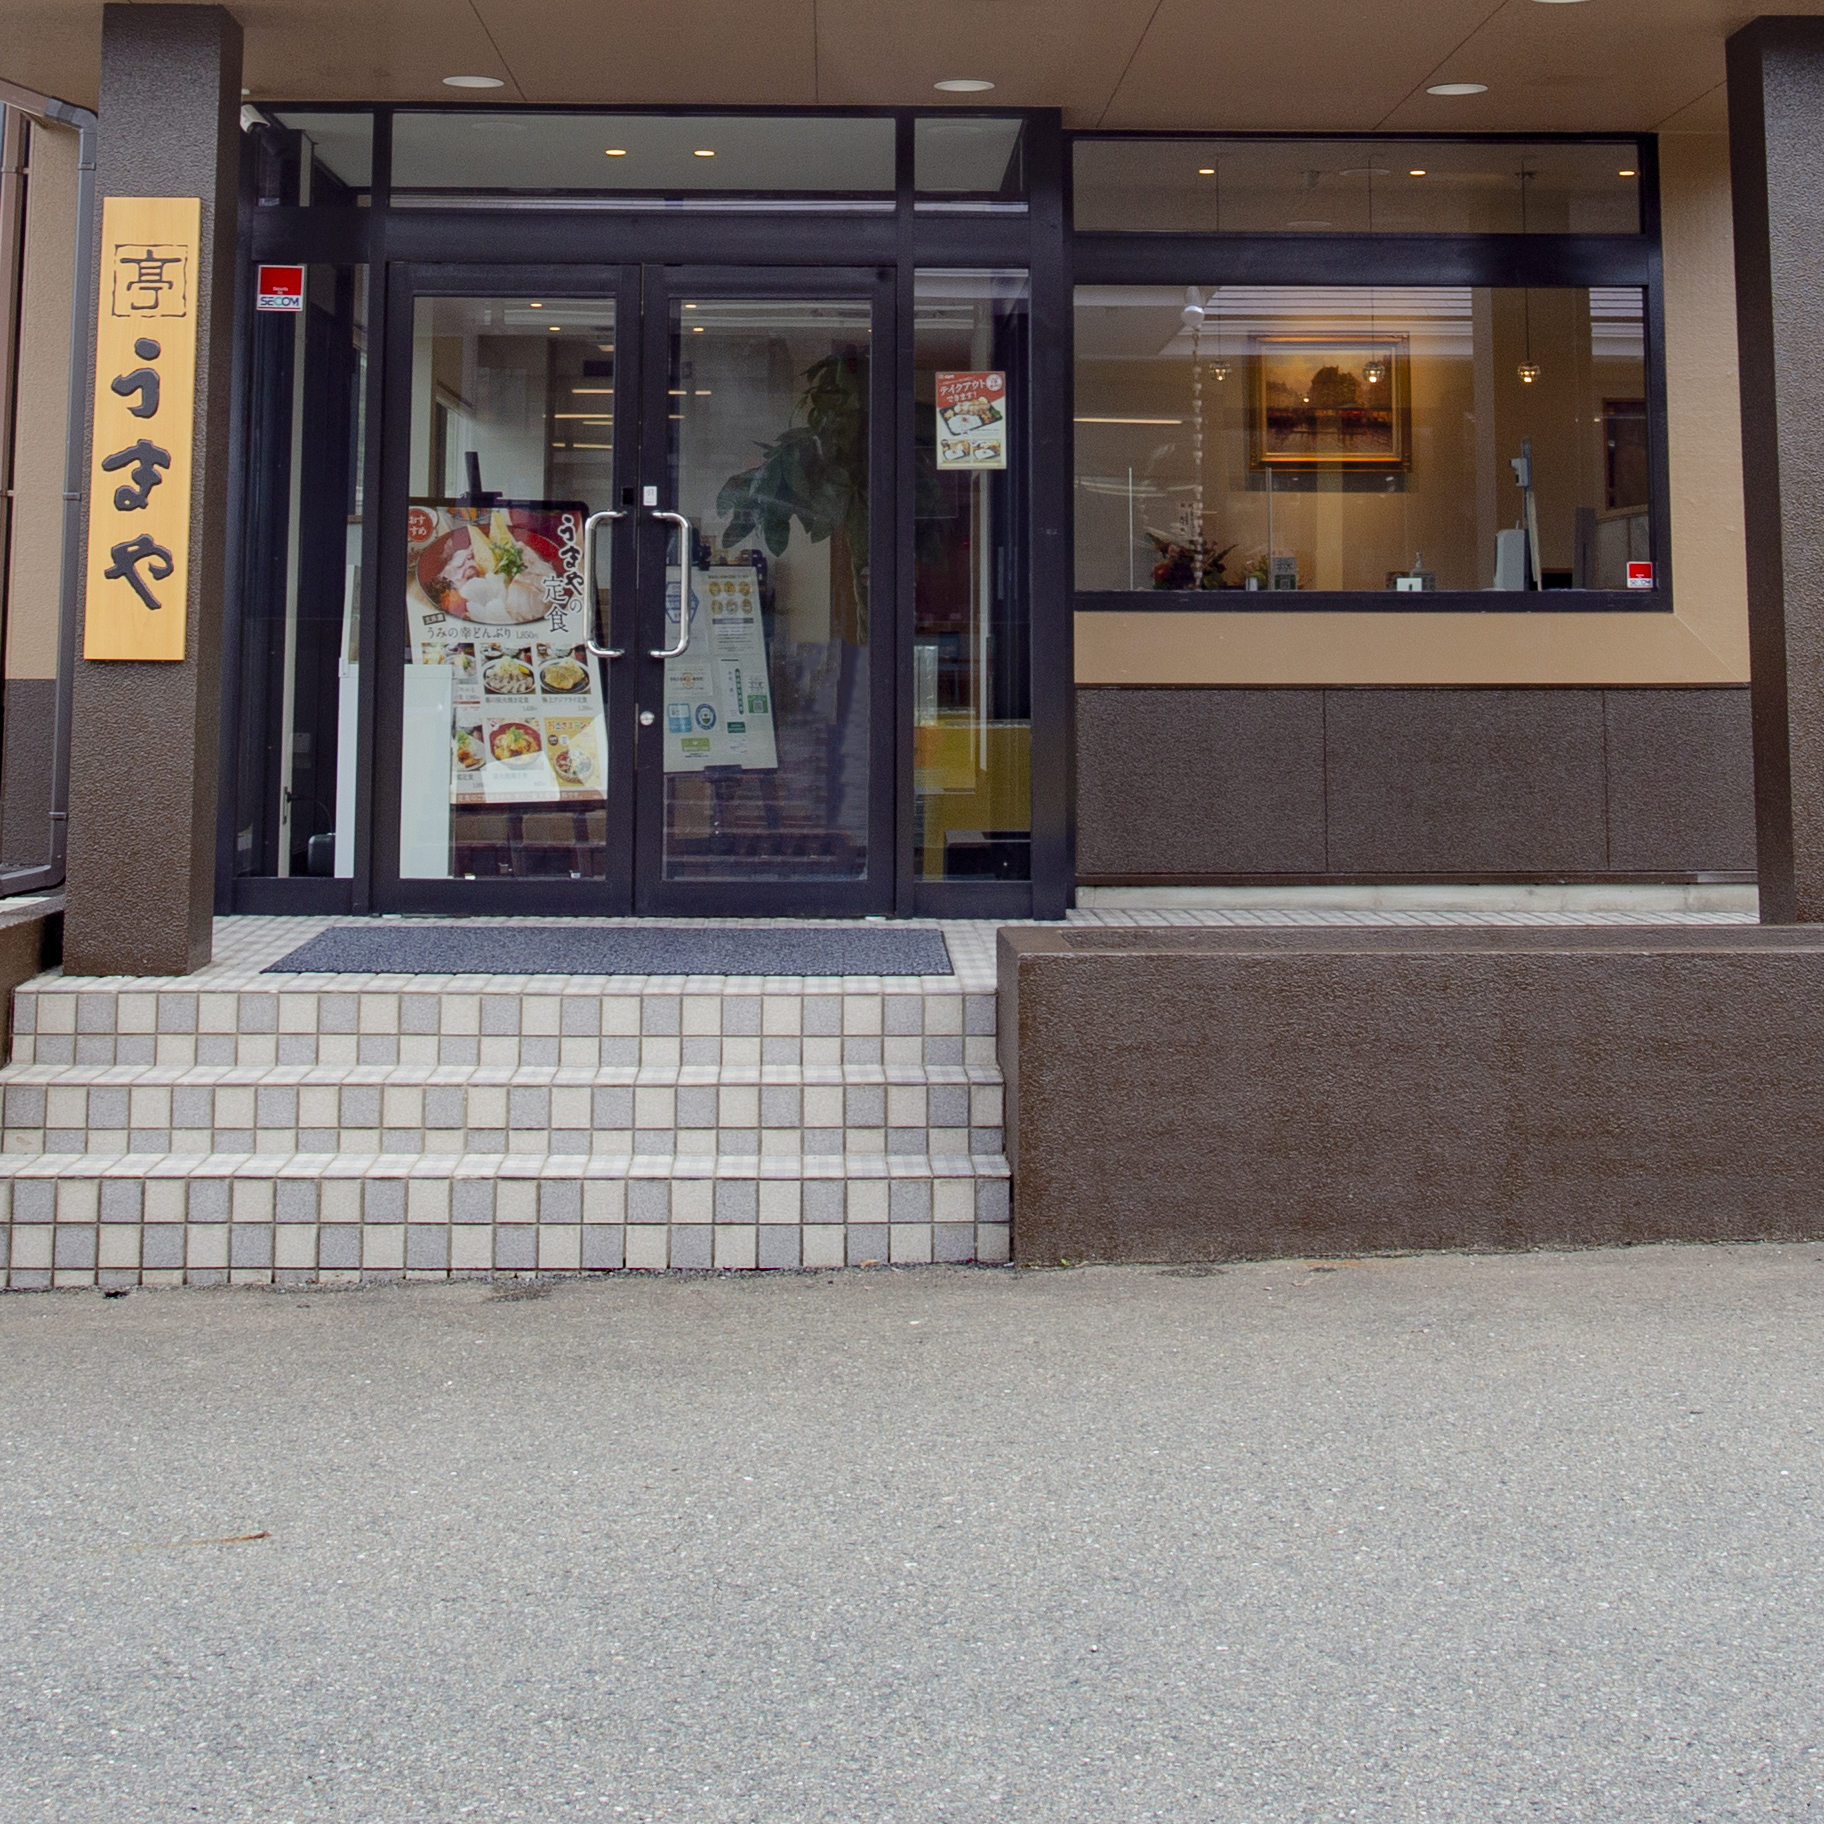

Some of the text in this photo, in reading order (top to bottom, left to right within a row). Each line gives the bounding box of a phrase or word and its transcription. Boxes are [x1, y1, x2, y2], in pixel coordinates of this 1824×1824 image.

[260, 296, 299, 306] SECOM
[940, 379, 986, 396] テイクアウト
[102, 337, 174, 611] うまや
[542, 576, 569, 633] 定食
